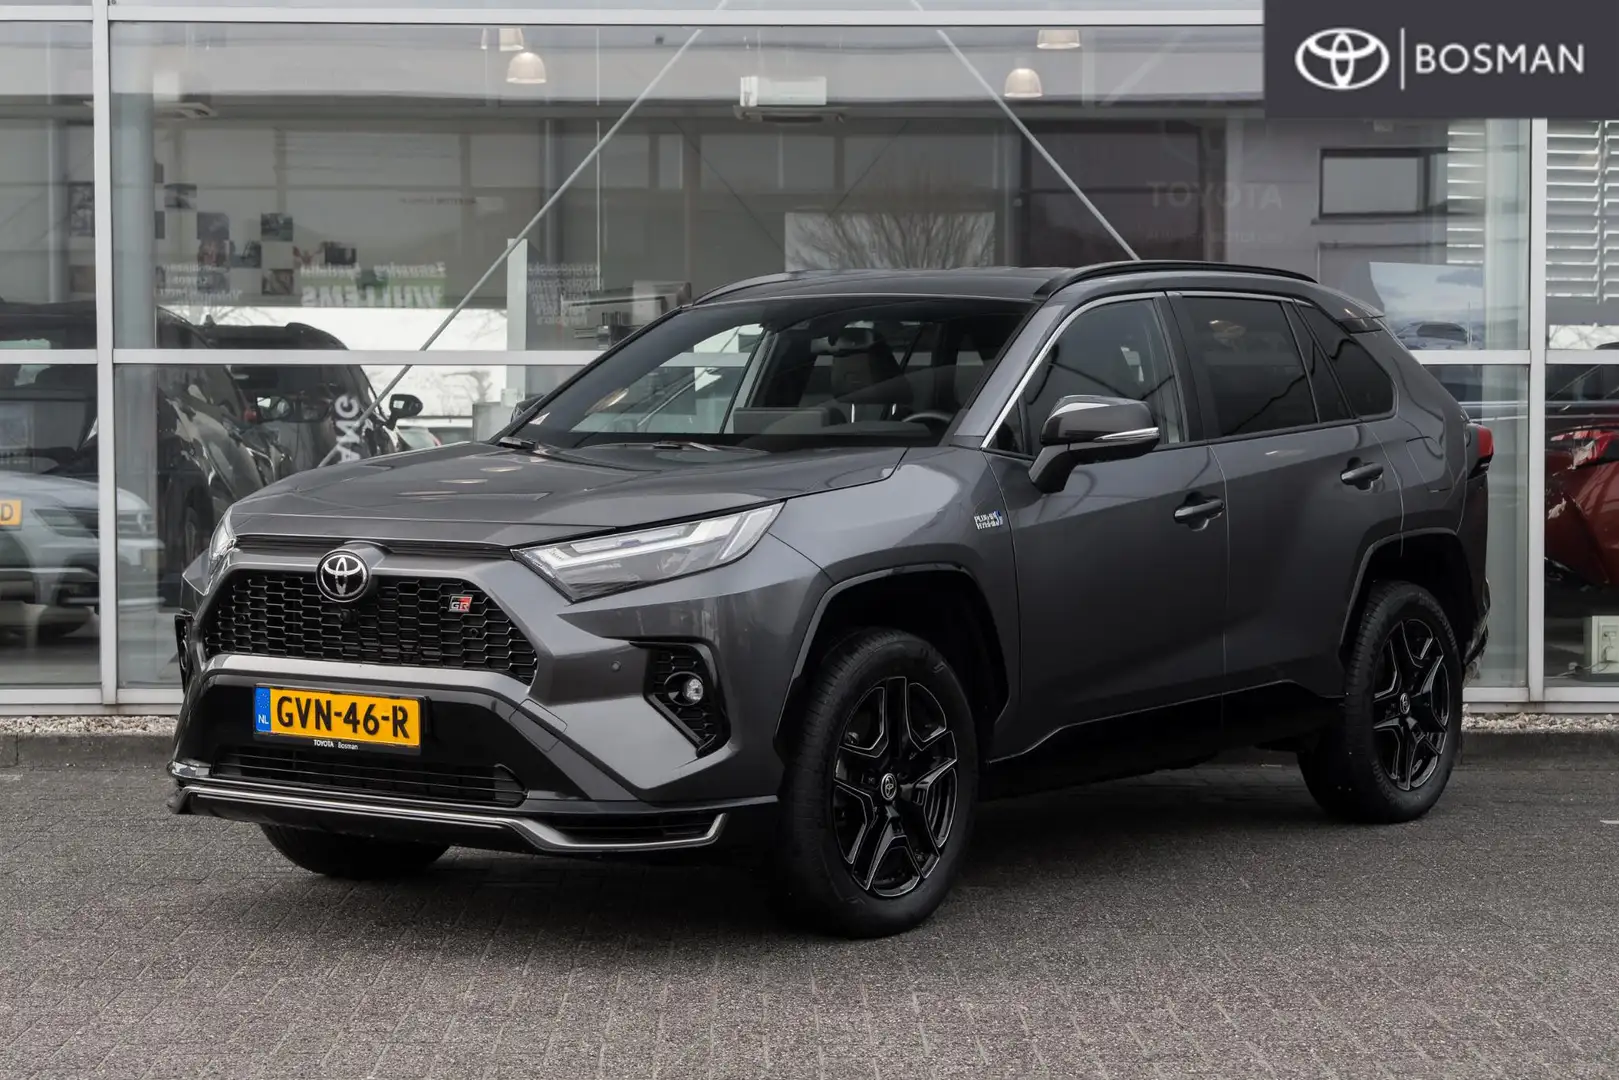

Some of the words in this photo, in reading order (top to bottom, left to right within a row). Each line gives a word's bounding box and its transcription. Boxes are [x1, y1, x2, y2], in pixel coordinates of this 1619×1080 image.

[1146, 181, 1282, 210] TOYOTA
[258, 714, 270, 725] NL
[276, 695, 410, 739] GVN-46-R
[313, 739, 335, 748] TOYOTA
[337, 741, 359, 750] Bosman
